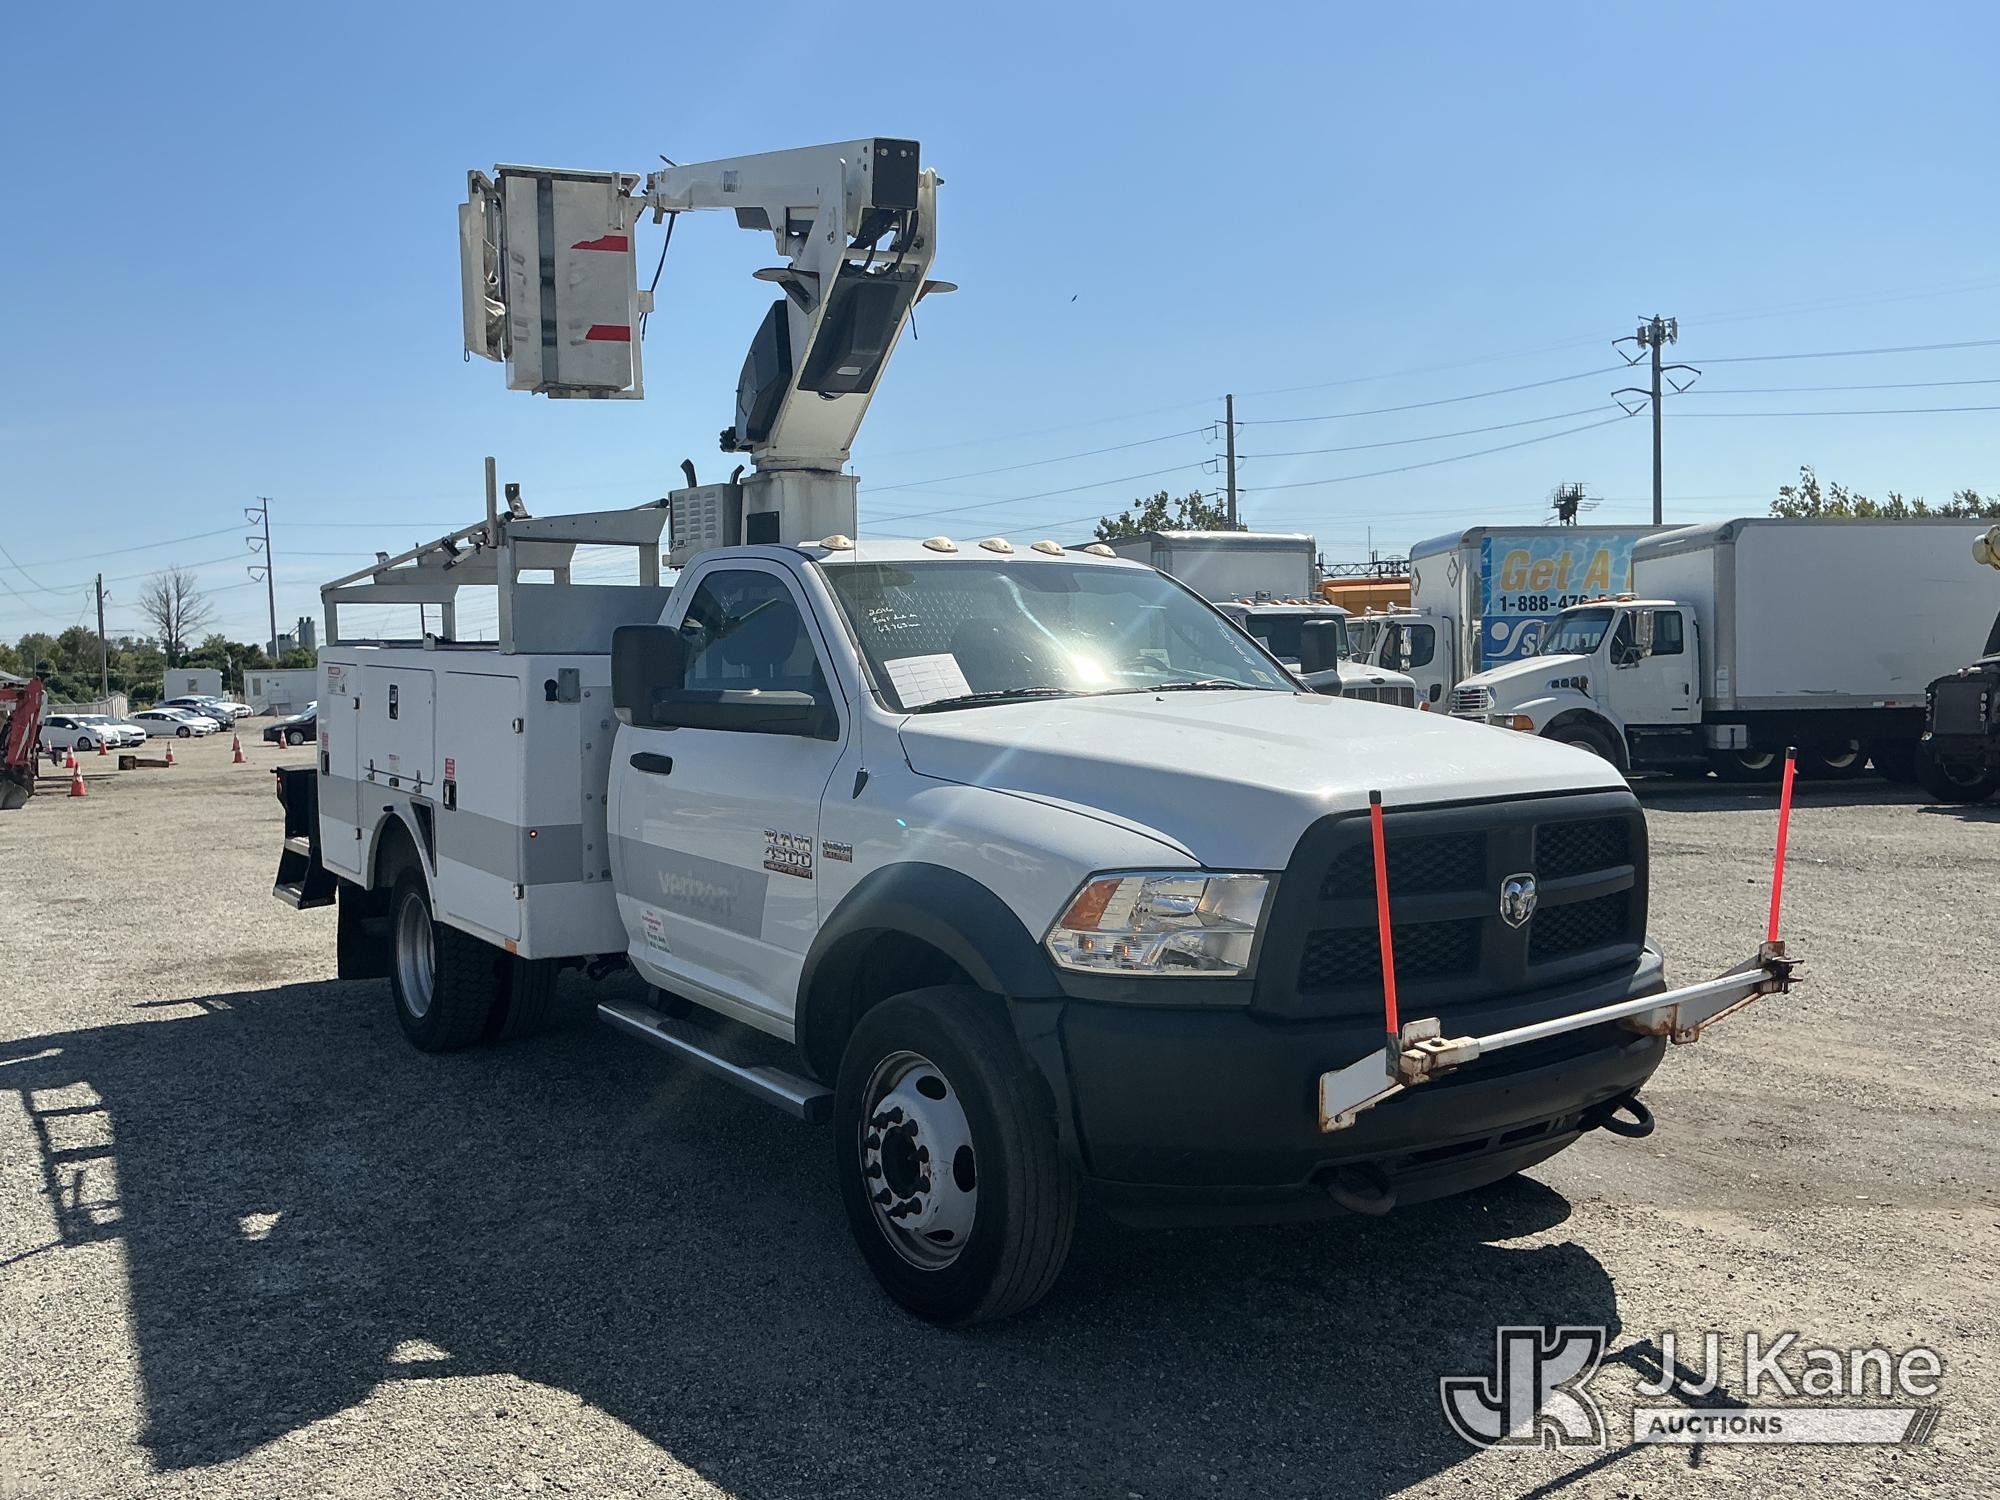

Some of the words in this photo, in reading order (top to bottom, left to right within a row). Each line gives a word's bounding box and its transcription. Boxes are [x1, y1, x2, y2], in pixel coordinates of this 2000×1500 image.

[1500, 549, 1573, 592] Get
[1582, 549, 1611, 591] A
[763, 828, 812, 852] RAM
[763, 844, 812, 868] 4500
